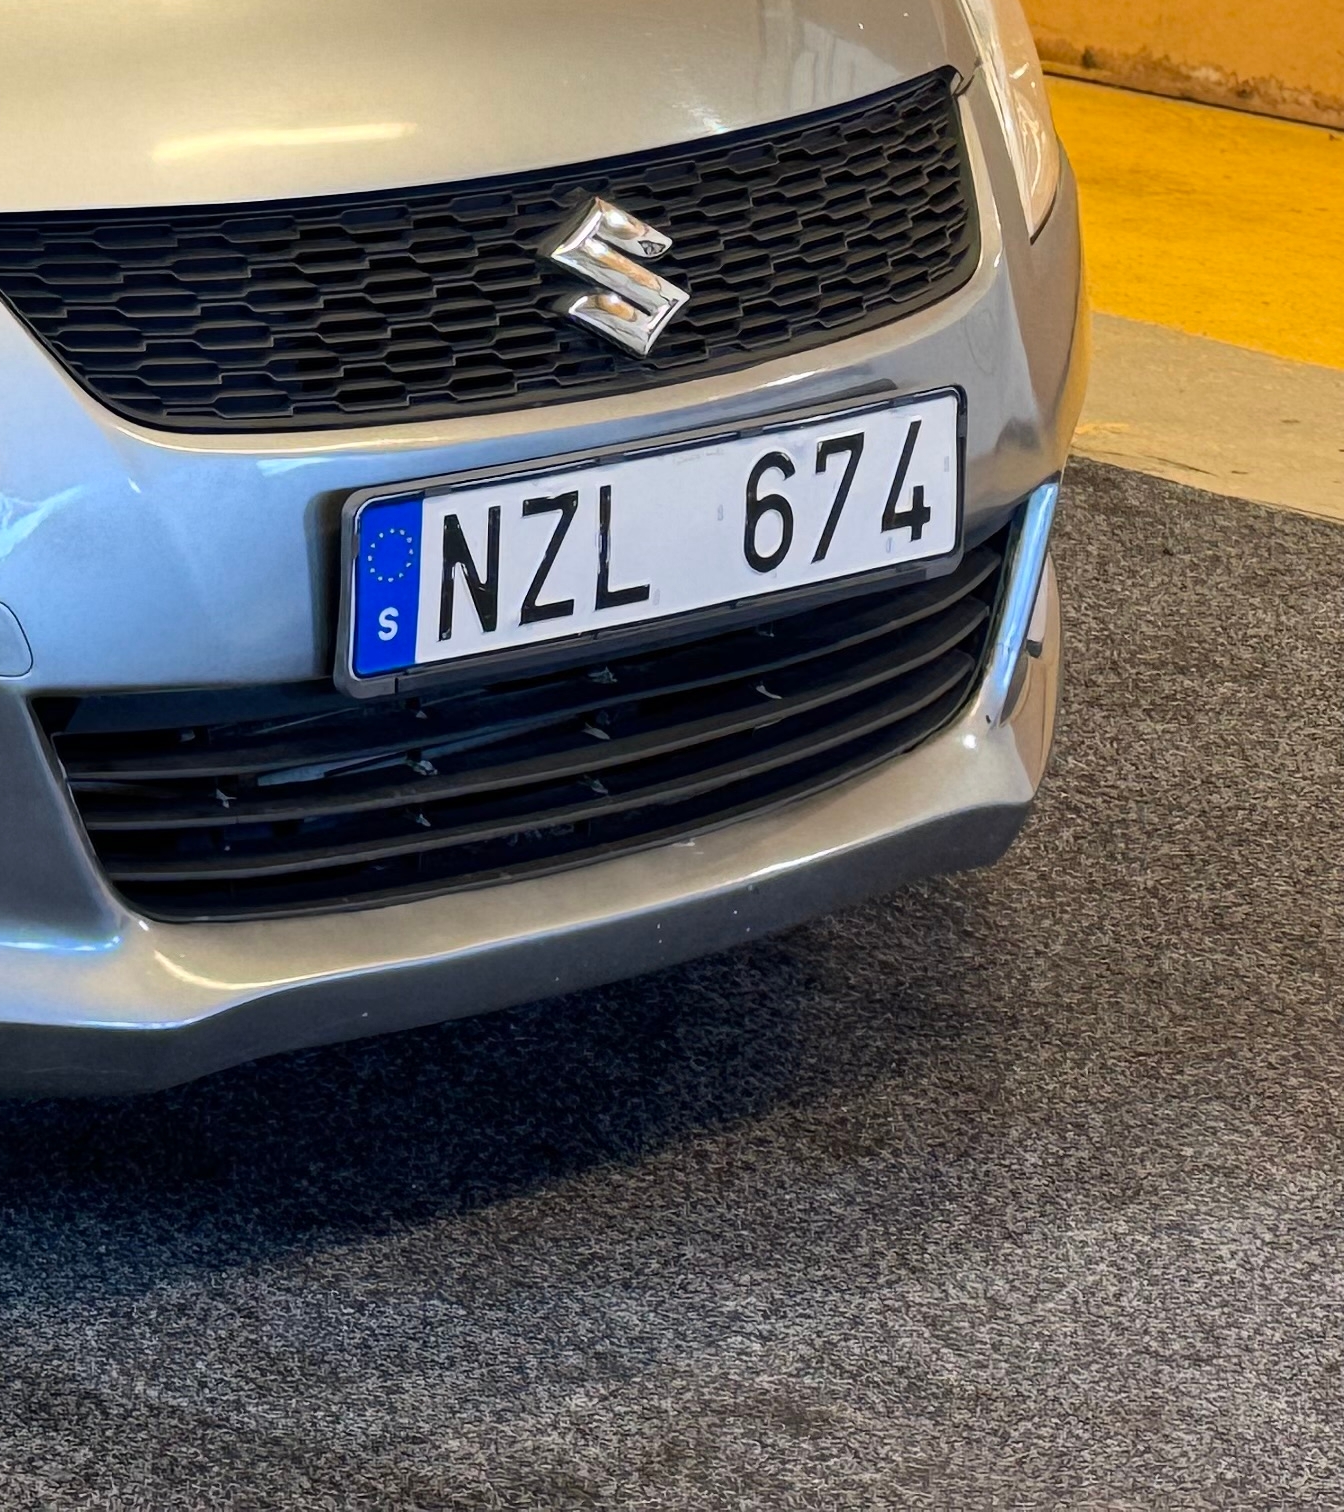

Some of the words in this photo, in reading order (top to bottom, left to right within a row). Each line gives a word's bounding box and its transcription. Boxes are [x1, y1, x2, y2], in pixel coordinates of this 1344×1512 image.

[437, 485, 651, 642] NZL
[743, 419, 931, 574] 674
[378, 606, 399, 641] S
